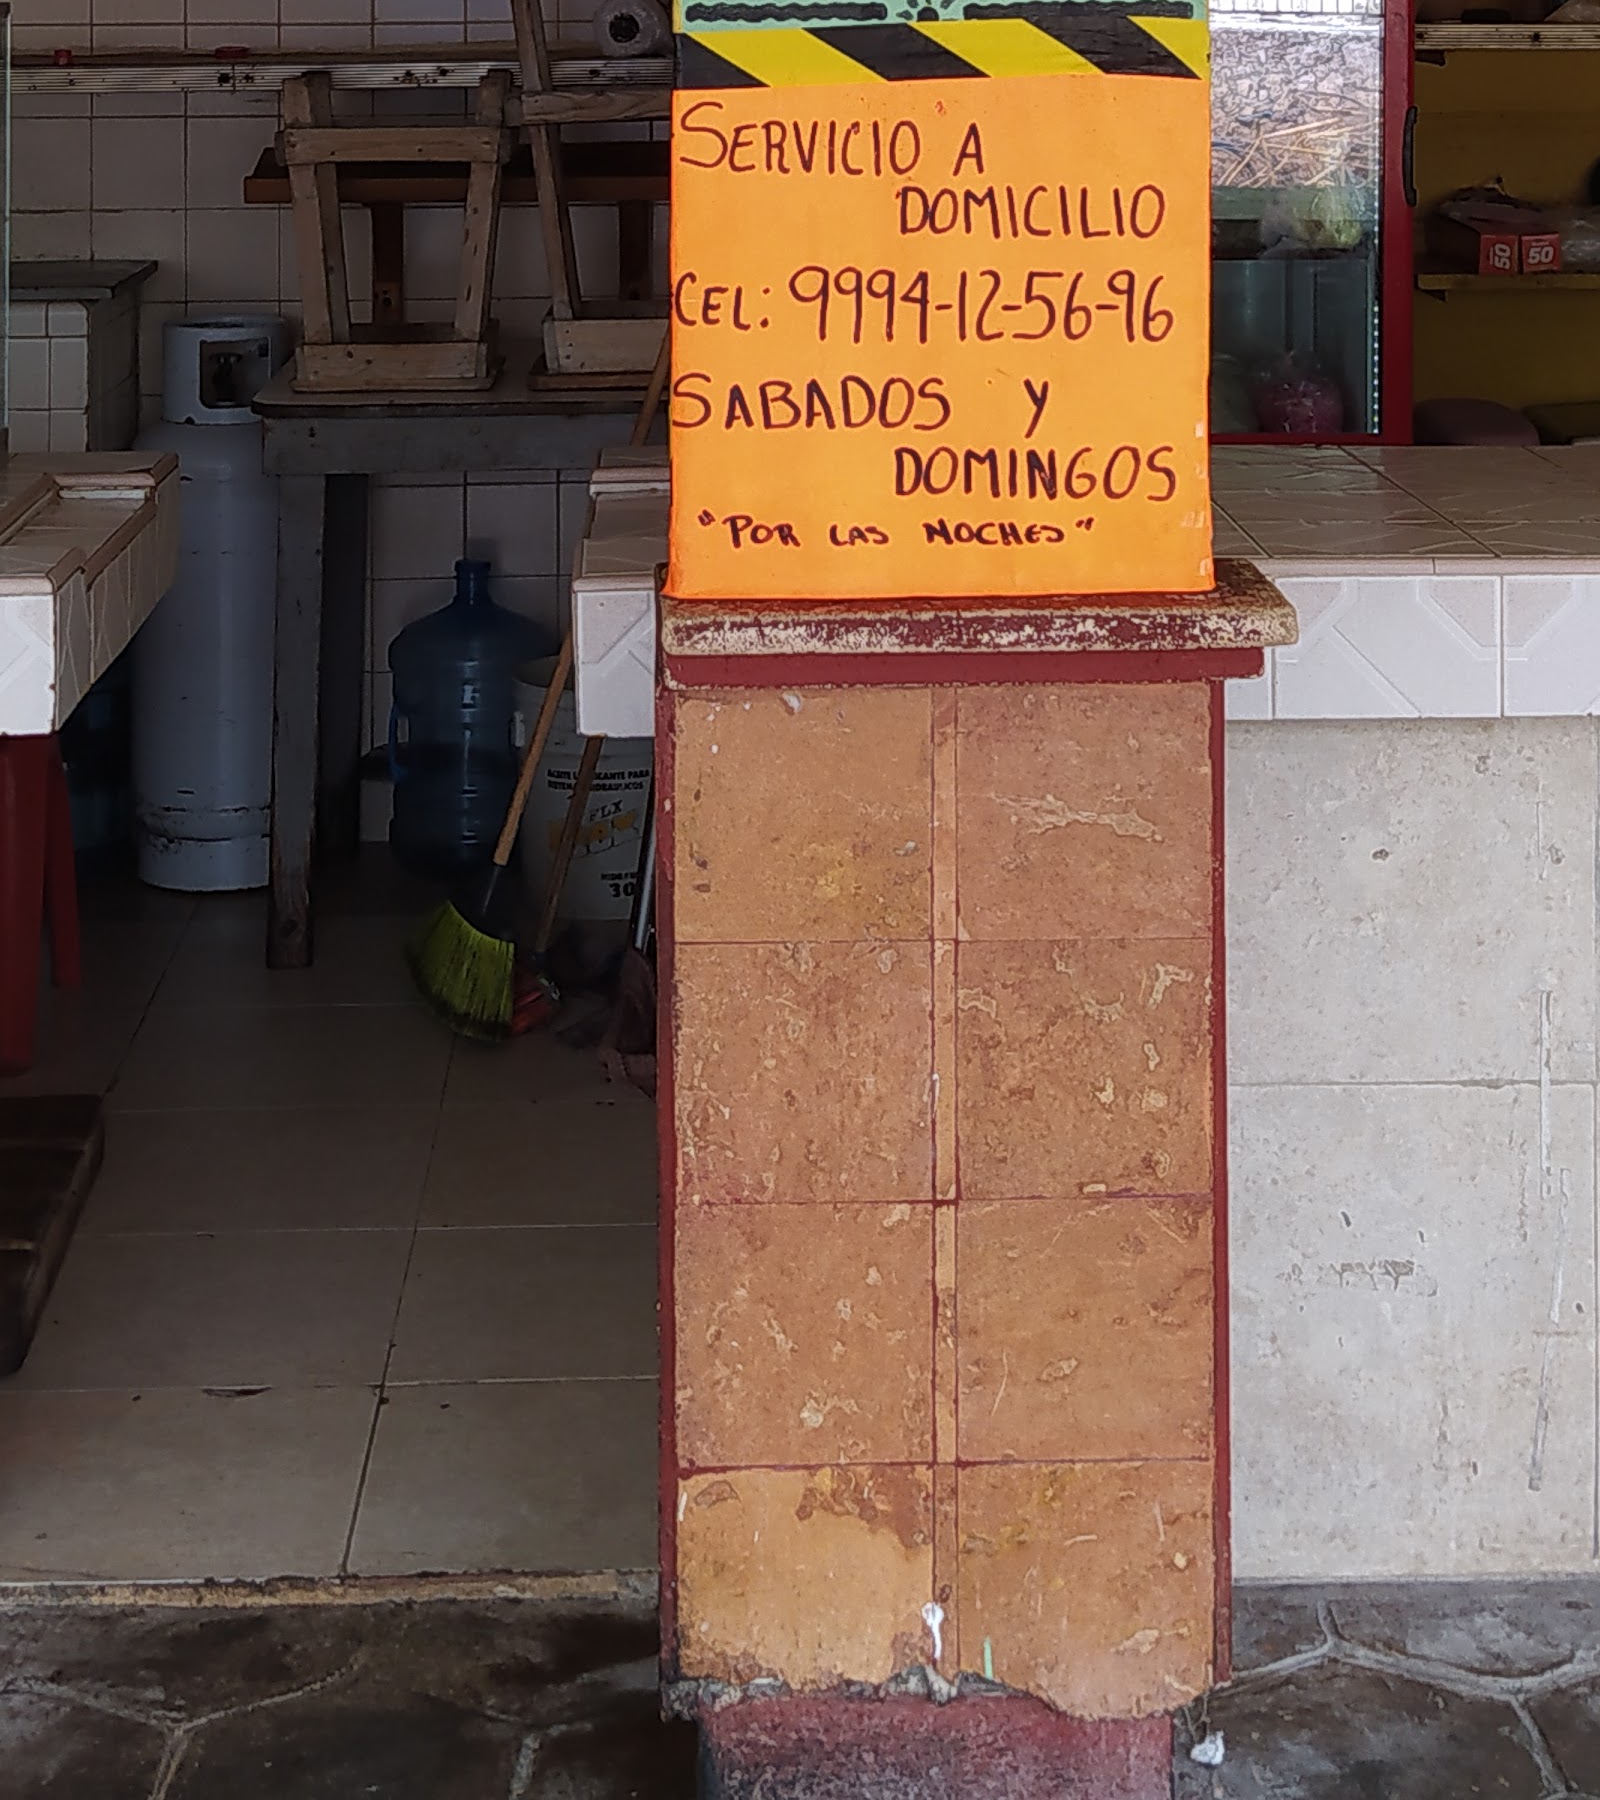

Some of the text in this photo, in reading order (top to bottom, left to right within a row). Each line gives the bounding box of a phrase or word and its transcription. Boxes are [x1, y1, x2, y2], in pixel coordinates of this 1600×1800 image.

[680, 102, 985, 176] SERVICIO A
[898, 185, 1165, 239] DOMICILIO
[1528, 246, 1554, 265] 50
[673, 266, 1174, 344] CEL: 9994-12-56-96
[672, 373, 1049, 439] SABADOS Y
[895, 446, 1176, 501] DOMINGOS
[830, 524, 889, 547] LAS
